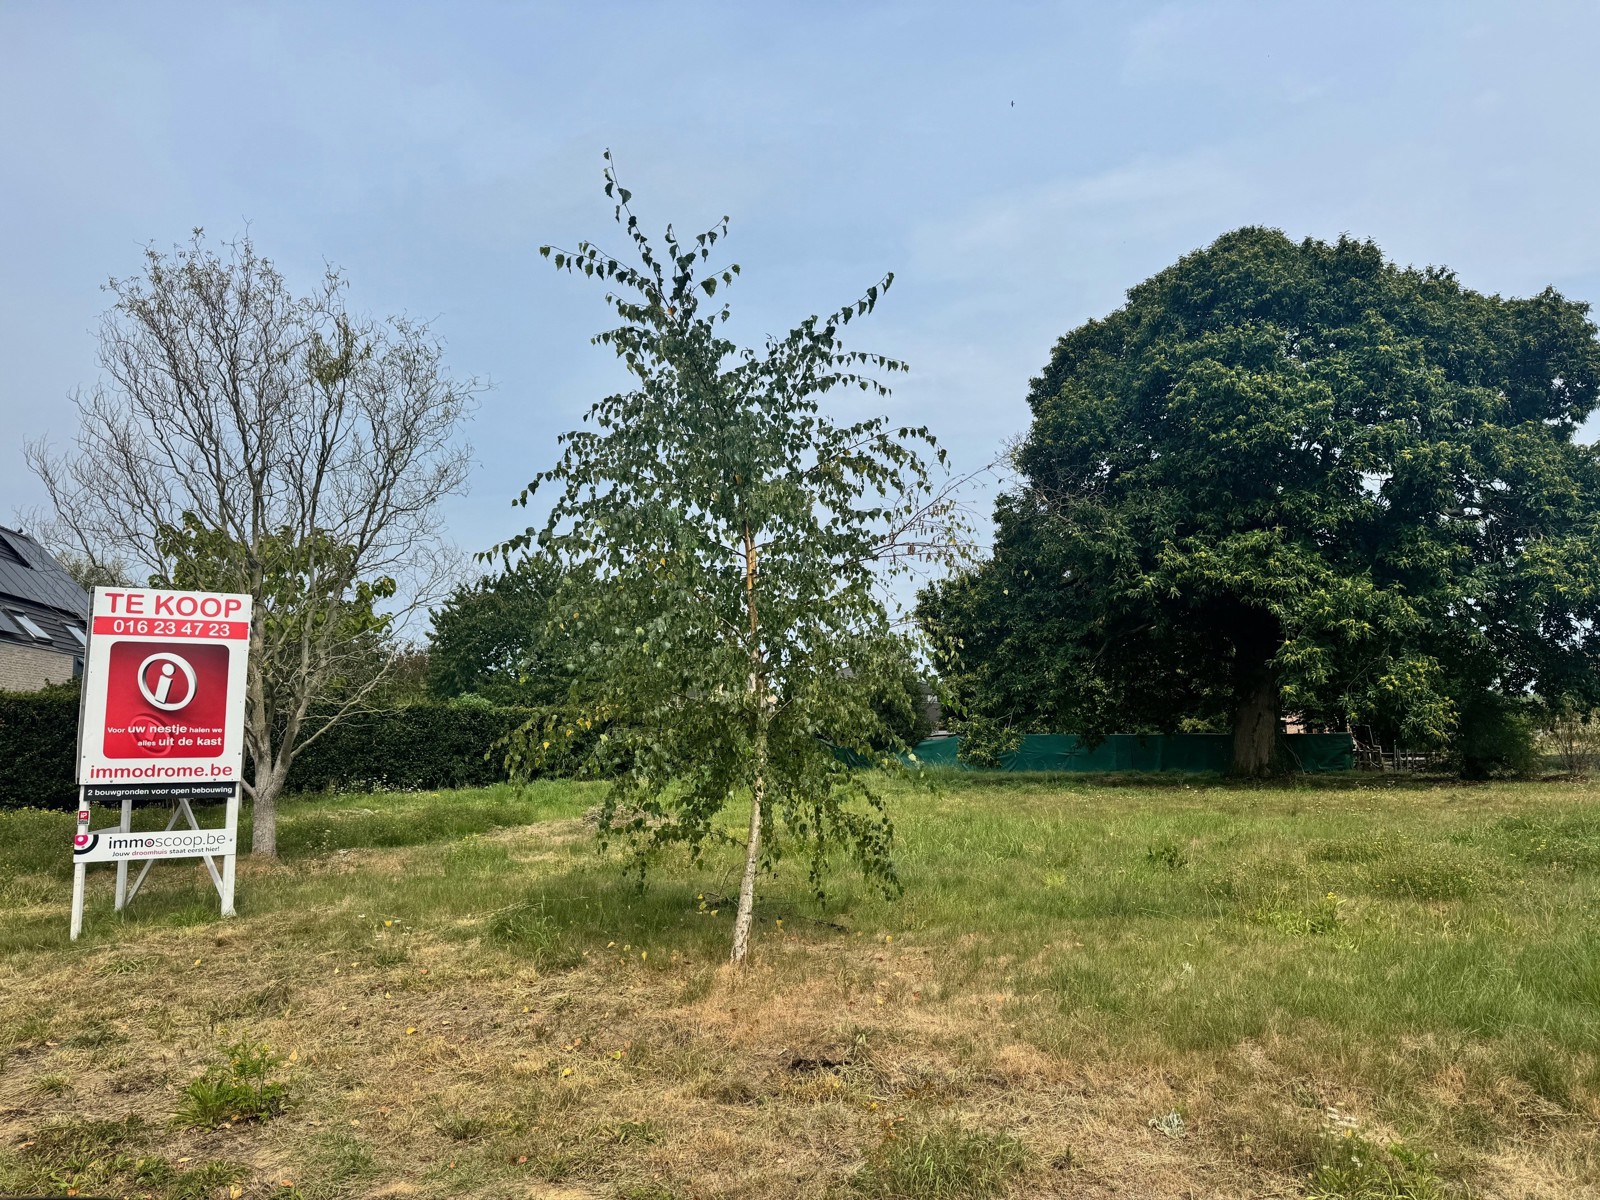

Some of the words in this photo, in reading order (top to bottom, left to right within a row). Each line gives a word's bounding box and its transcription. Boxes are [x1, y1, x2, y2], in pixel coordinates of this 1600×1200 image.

[105, 593, 145, 614] TE
[154, 595, 242, 618] KOOP
[113, 619, 148, 633] 016
[153, 621, 176, 635] 23
[180, 622, 204, 636] 47
[208, 623, 230, 637] 23
[107, 726, 126, 734] Voor
[127, 726, 145, 734] uw
[149, 724, 188, 735] nestje
[137, 739, 156, 747] alles
[158, 737, 174, 746] uit
[177, 737, 193, 746] de
[196, 736, 222, 746] kast
[90, 763, 233, 778] immodrome.be
[94, 788, 149, 797] bouwgronden
[170, 787, 190, 796] open
[191, 786, 233, 795] bebouwing
[108, 833, 226, 849] immoscoop.be
[112, 850, 130, 858] Jouw
[131, 849, 168, 857] droomhuis
